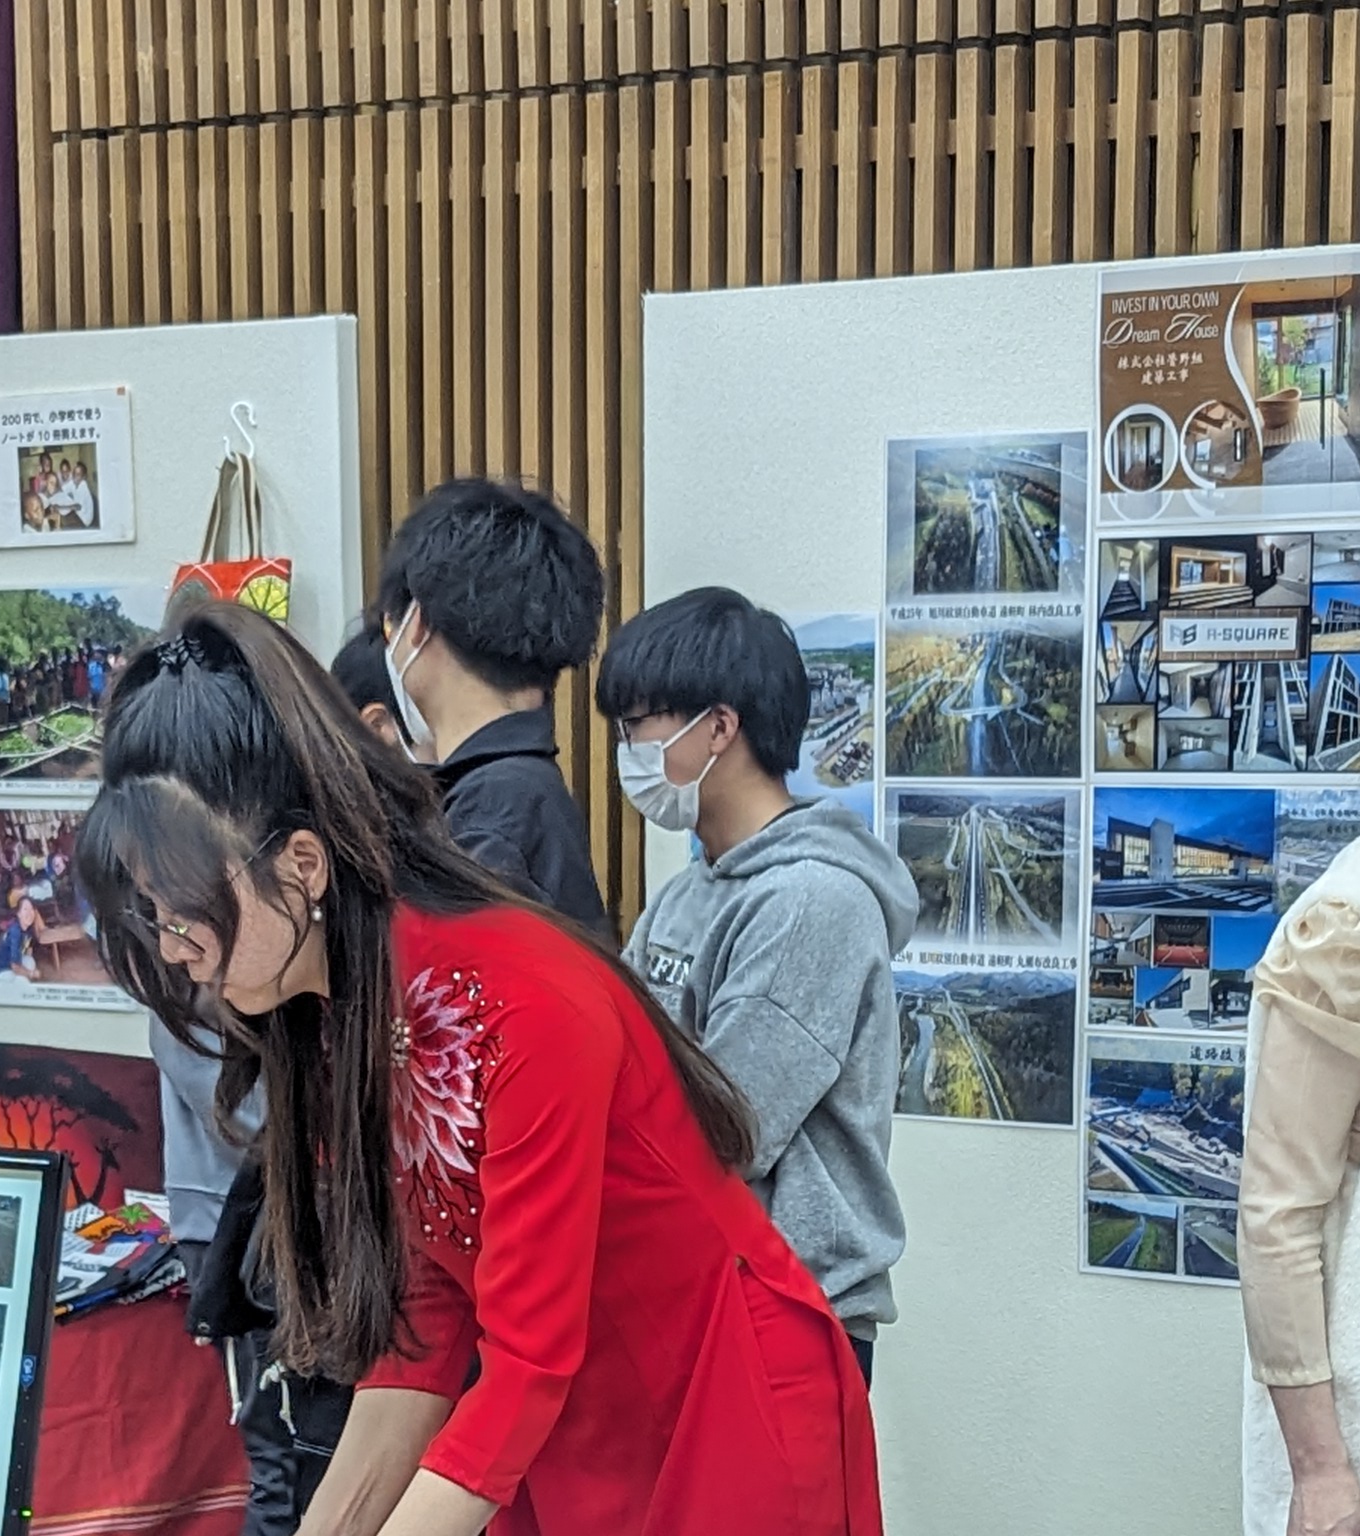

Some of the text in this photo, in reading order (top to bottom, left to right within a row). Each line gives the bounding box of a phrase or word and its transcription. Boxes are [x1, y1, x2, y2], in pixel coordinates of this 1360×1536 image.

[1112, 290, 1219, 314] INVEST IN YOUR OWN
[1102, 312, 1219, 349] Dream House
